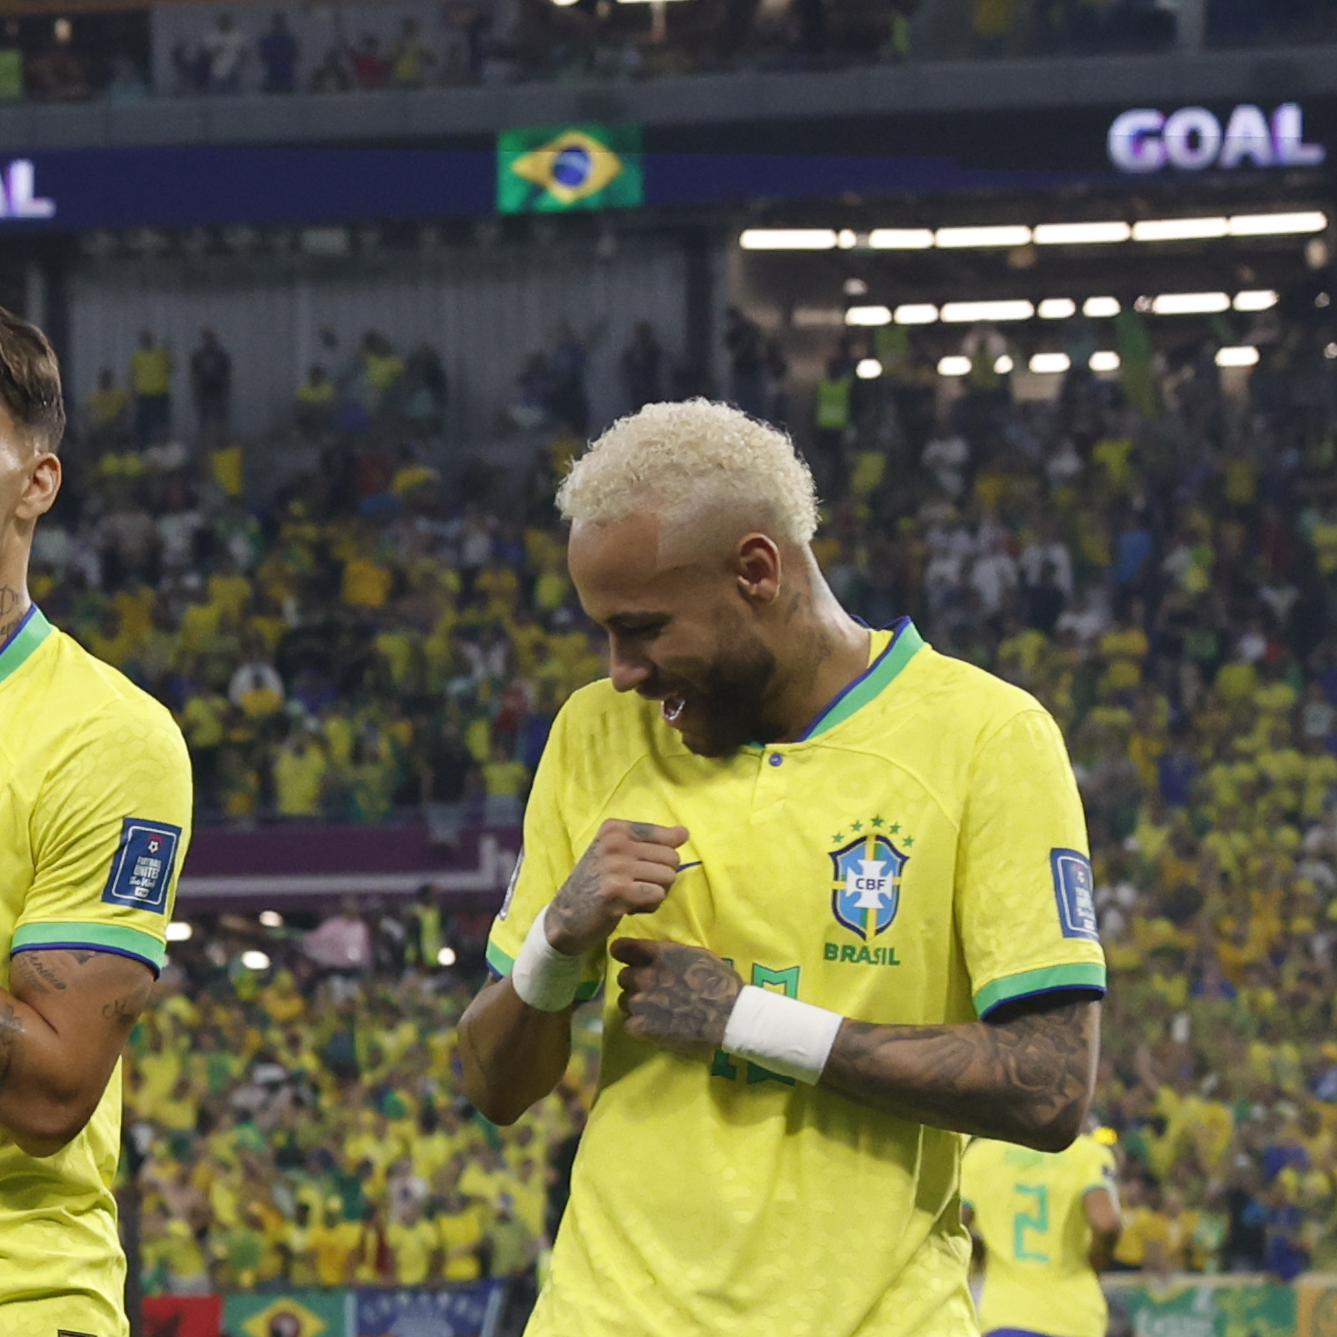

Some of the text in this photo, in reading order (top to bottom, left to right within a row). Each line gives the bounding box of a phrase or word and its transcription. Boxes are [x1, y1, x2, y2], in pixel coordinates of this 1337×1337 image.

[1107, 102, 1326, 172] GOAL
[855, 877, 886, 892] CBF
[824, 942, 901, 967] BRASIL
[1014, 1183, 1049, 1264] 2
